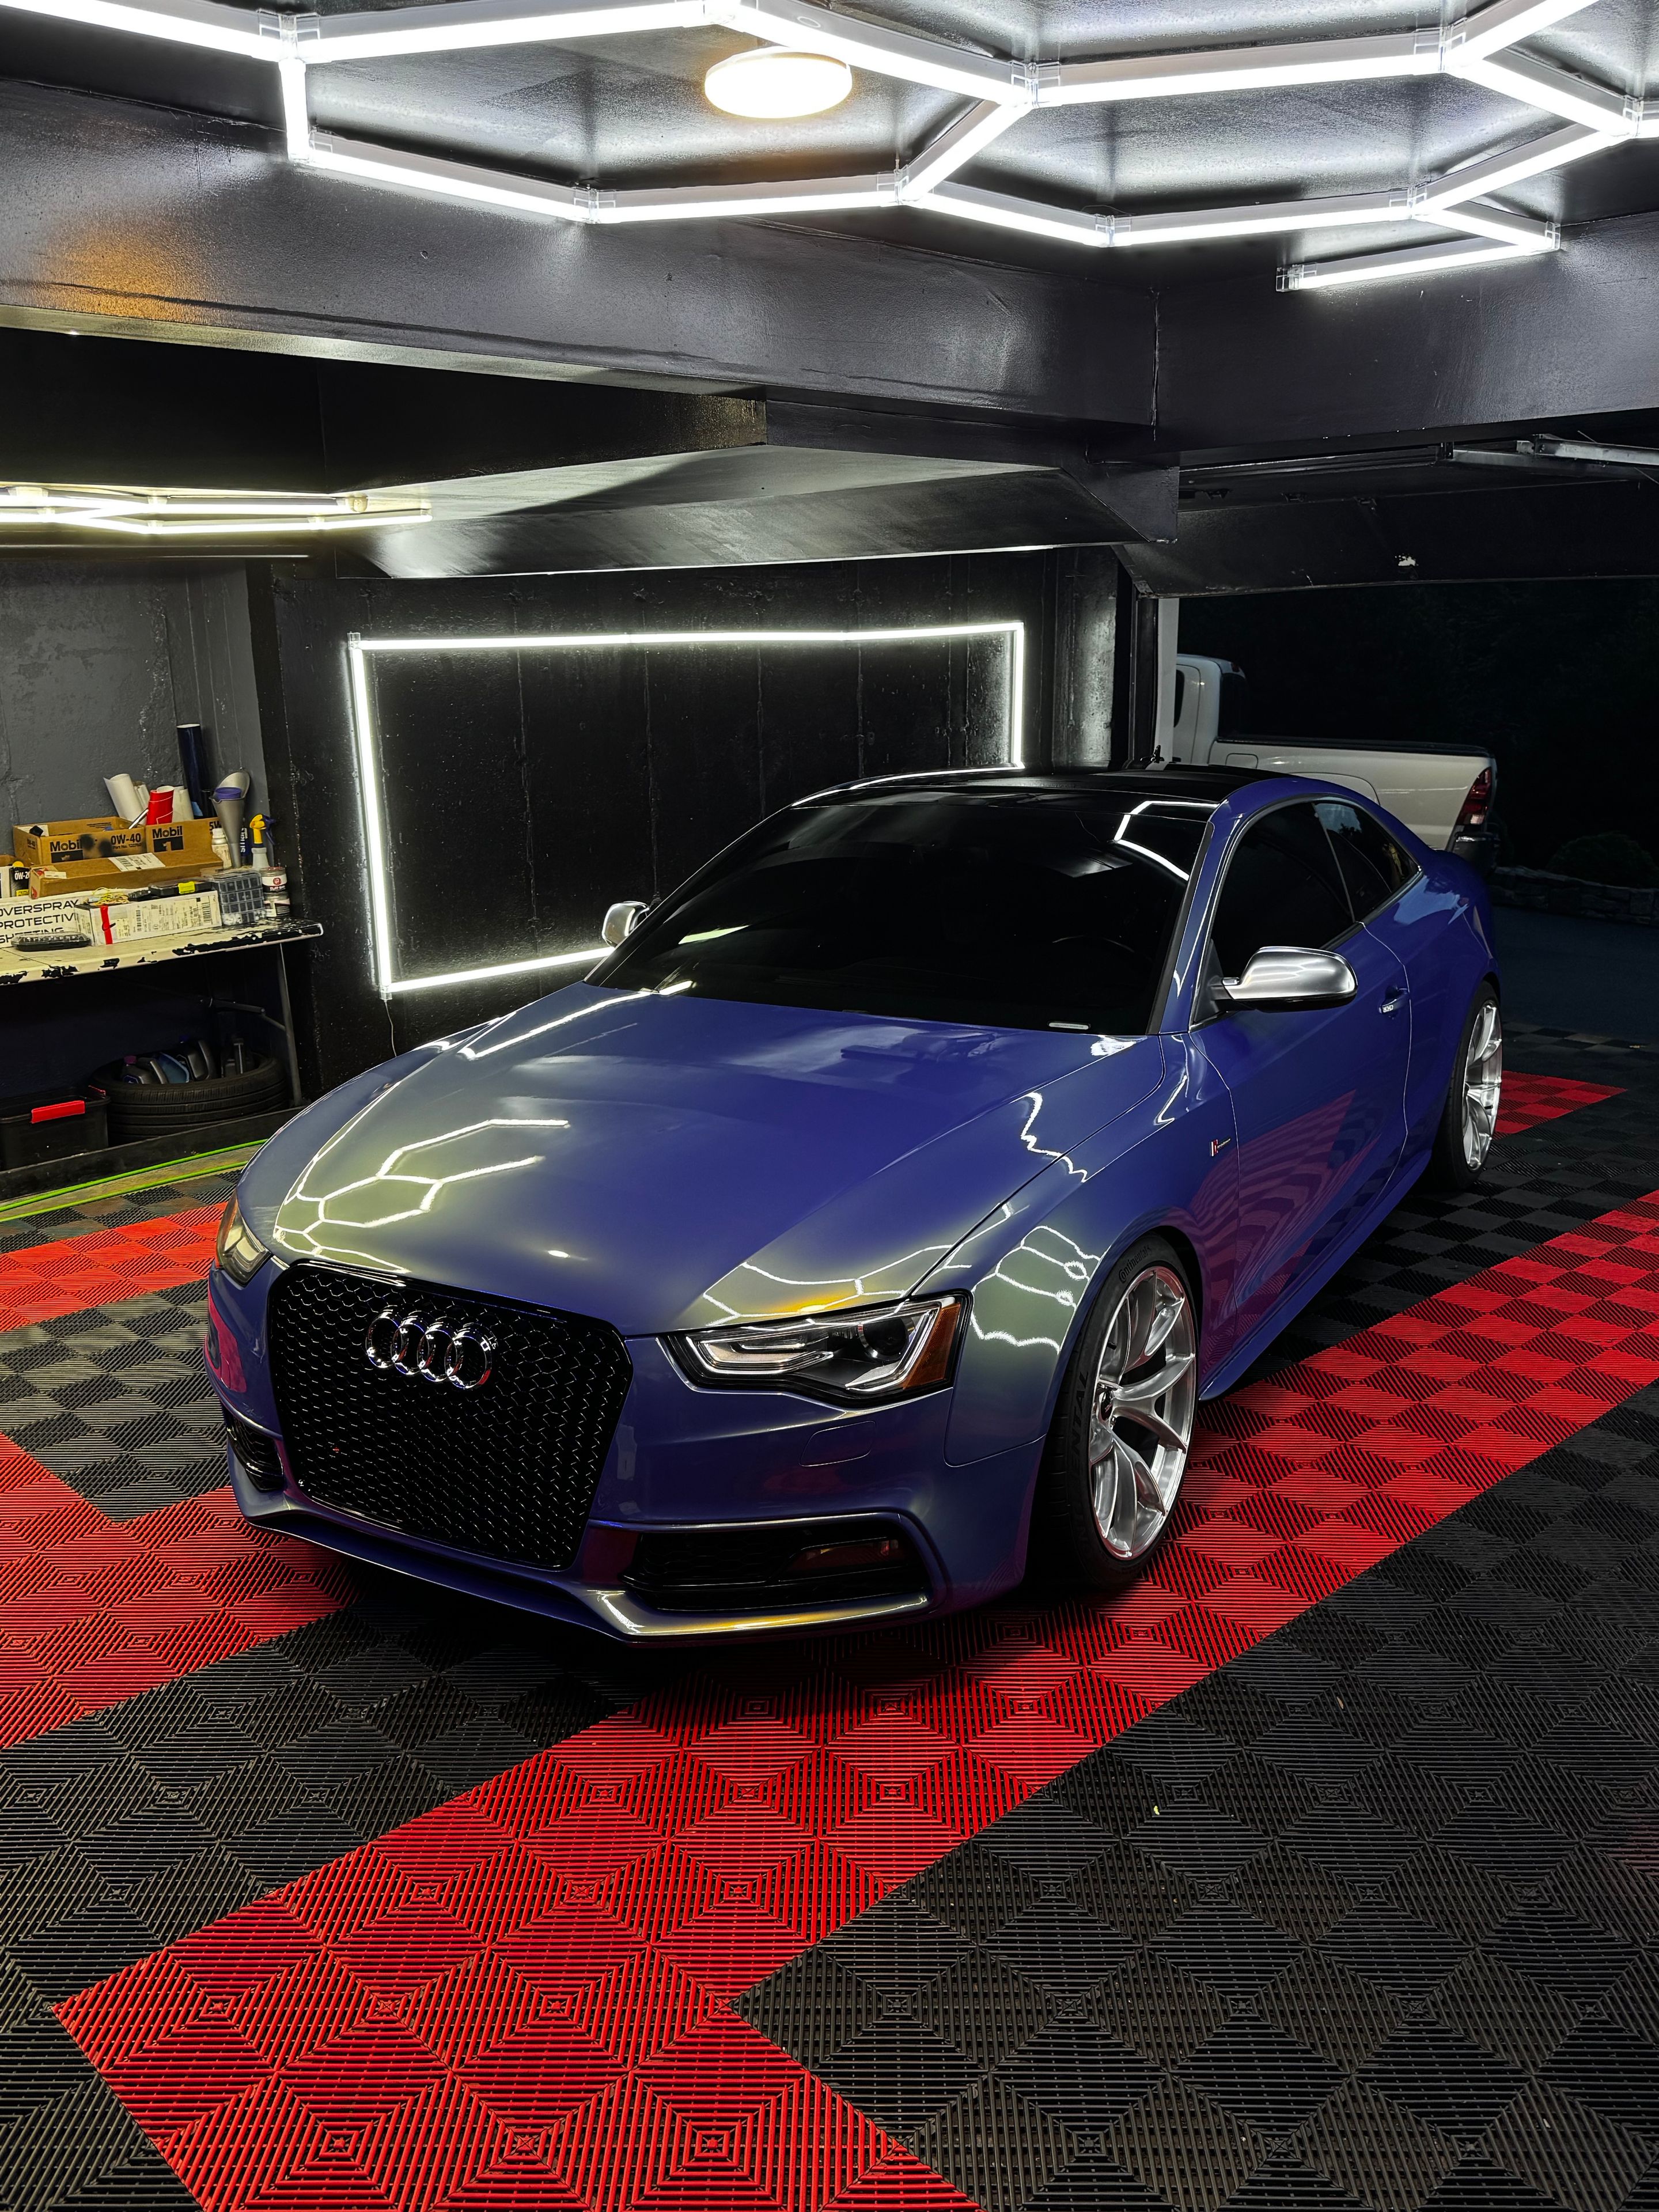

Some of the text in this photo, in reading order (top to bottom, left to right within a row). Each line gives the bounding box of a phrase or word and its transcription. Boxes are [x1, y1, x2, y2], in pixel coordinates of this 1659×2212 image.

[111, 833, 141, 845] 0W-40
[152, 825, 183, 839] Mobil
[0, 912, 76, 929] ROTECTIV
